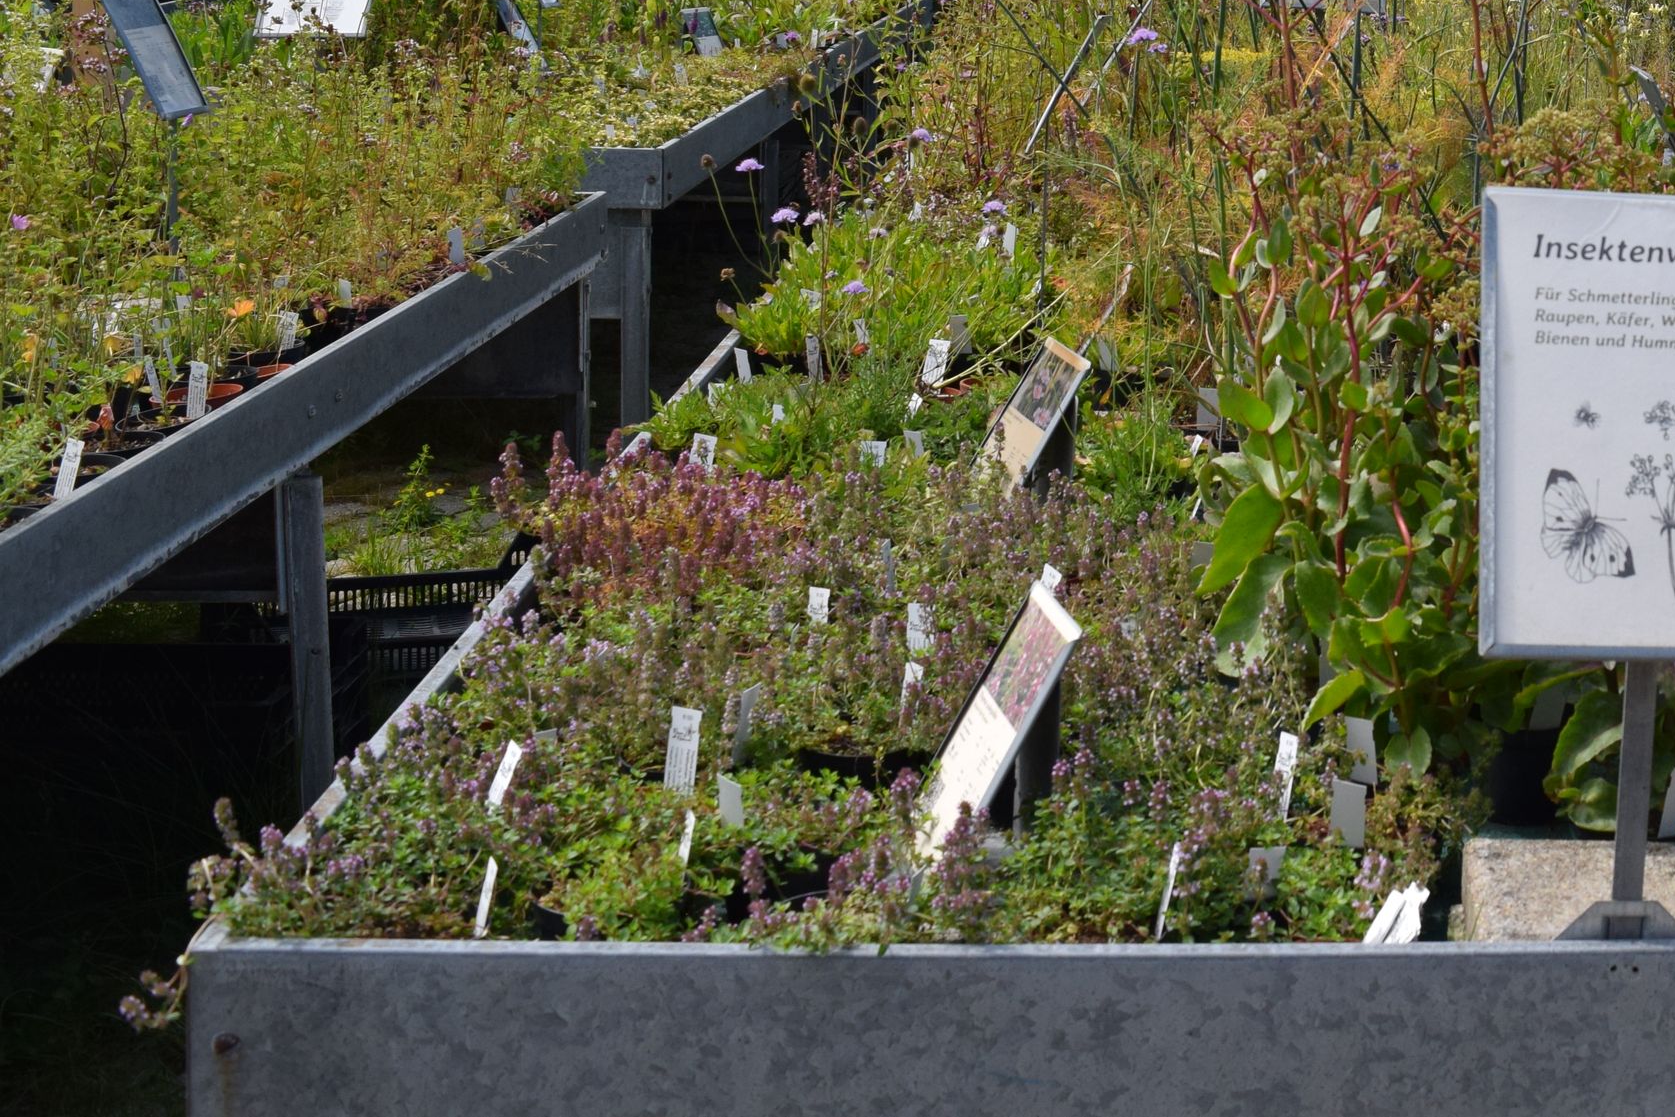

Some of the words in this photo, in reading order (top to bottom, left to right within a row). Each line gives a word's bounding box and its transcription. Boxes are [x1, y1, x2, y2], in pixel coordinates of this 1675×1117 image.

[1534, 287, 1562, 302] Für
[1534, 308, 1600, 327] Raupen,
[1606, 312, 1655, 328] Käfer,
[1534, 330, 1590, 346] Bienen
[1595, 334, 1626, 348] und
